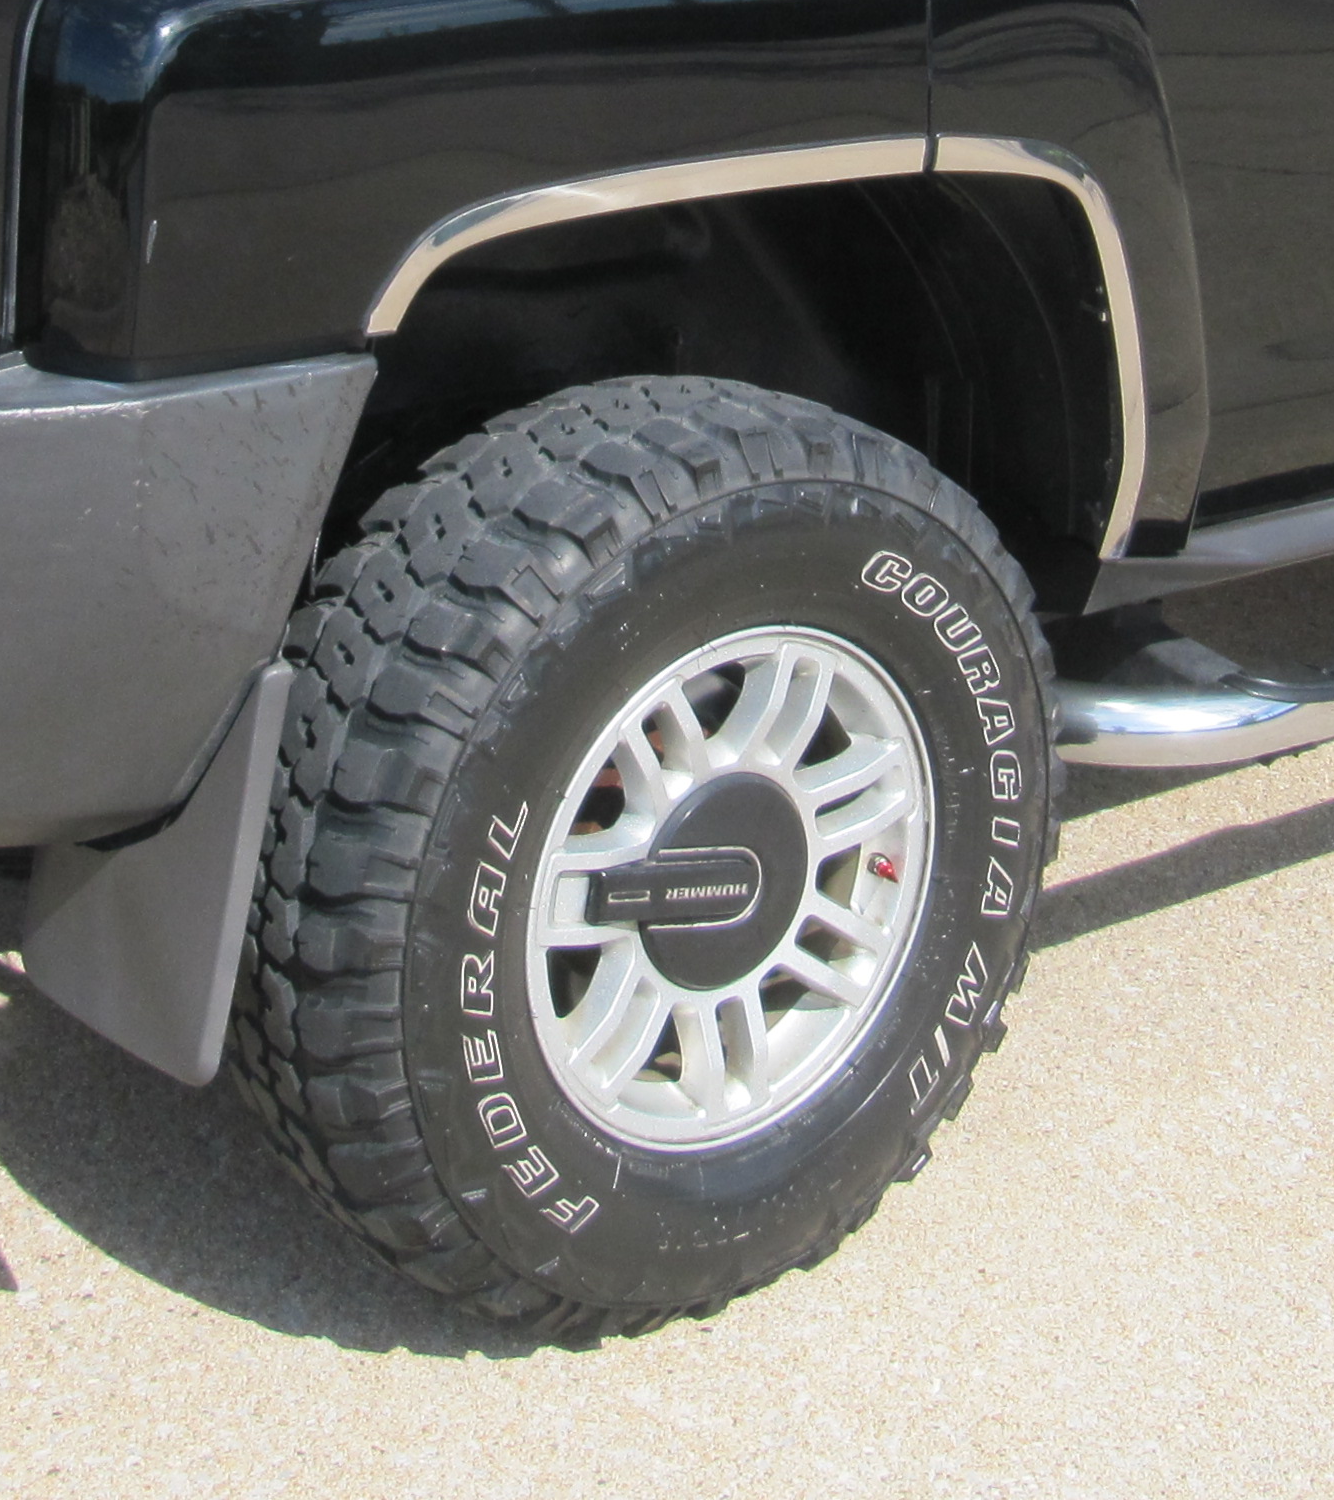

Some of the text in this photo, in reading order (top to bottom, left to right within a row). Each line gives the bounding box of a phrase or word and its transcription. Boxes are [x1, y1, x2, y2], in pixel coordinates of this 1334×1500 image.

[461, 800, 599, 1233] FEDERAL
[665, 882, 749, 901] HUMMER
[861, 550, 1022, 1117] COURAGIA M/T
